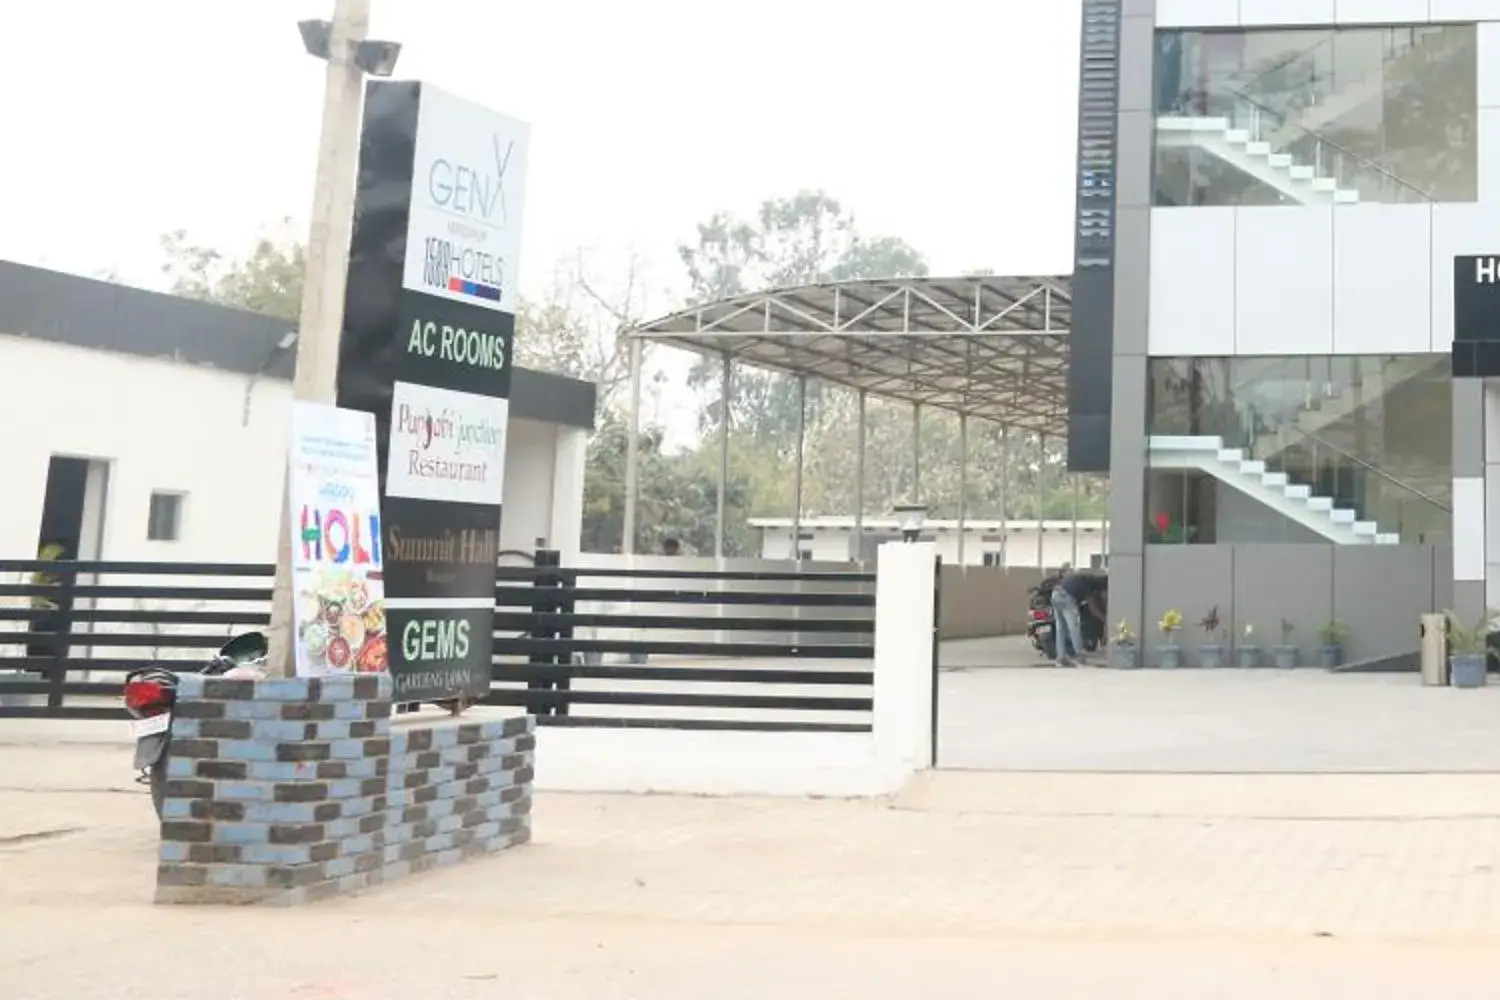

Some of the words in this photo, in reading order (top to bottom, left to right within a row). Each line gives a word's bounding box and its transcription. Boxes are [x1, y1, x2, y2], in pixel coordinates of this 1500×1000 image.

[429, 132, 514, 222] GENX
[407, 319, 436, 357] AC
[440, 326, 505, 370] ROOMS
[407, 449, 488, 484] Restaurant
[300, 504, 381, 565] HOLI
[403, 619, 472, 662] GEMS
